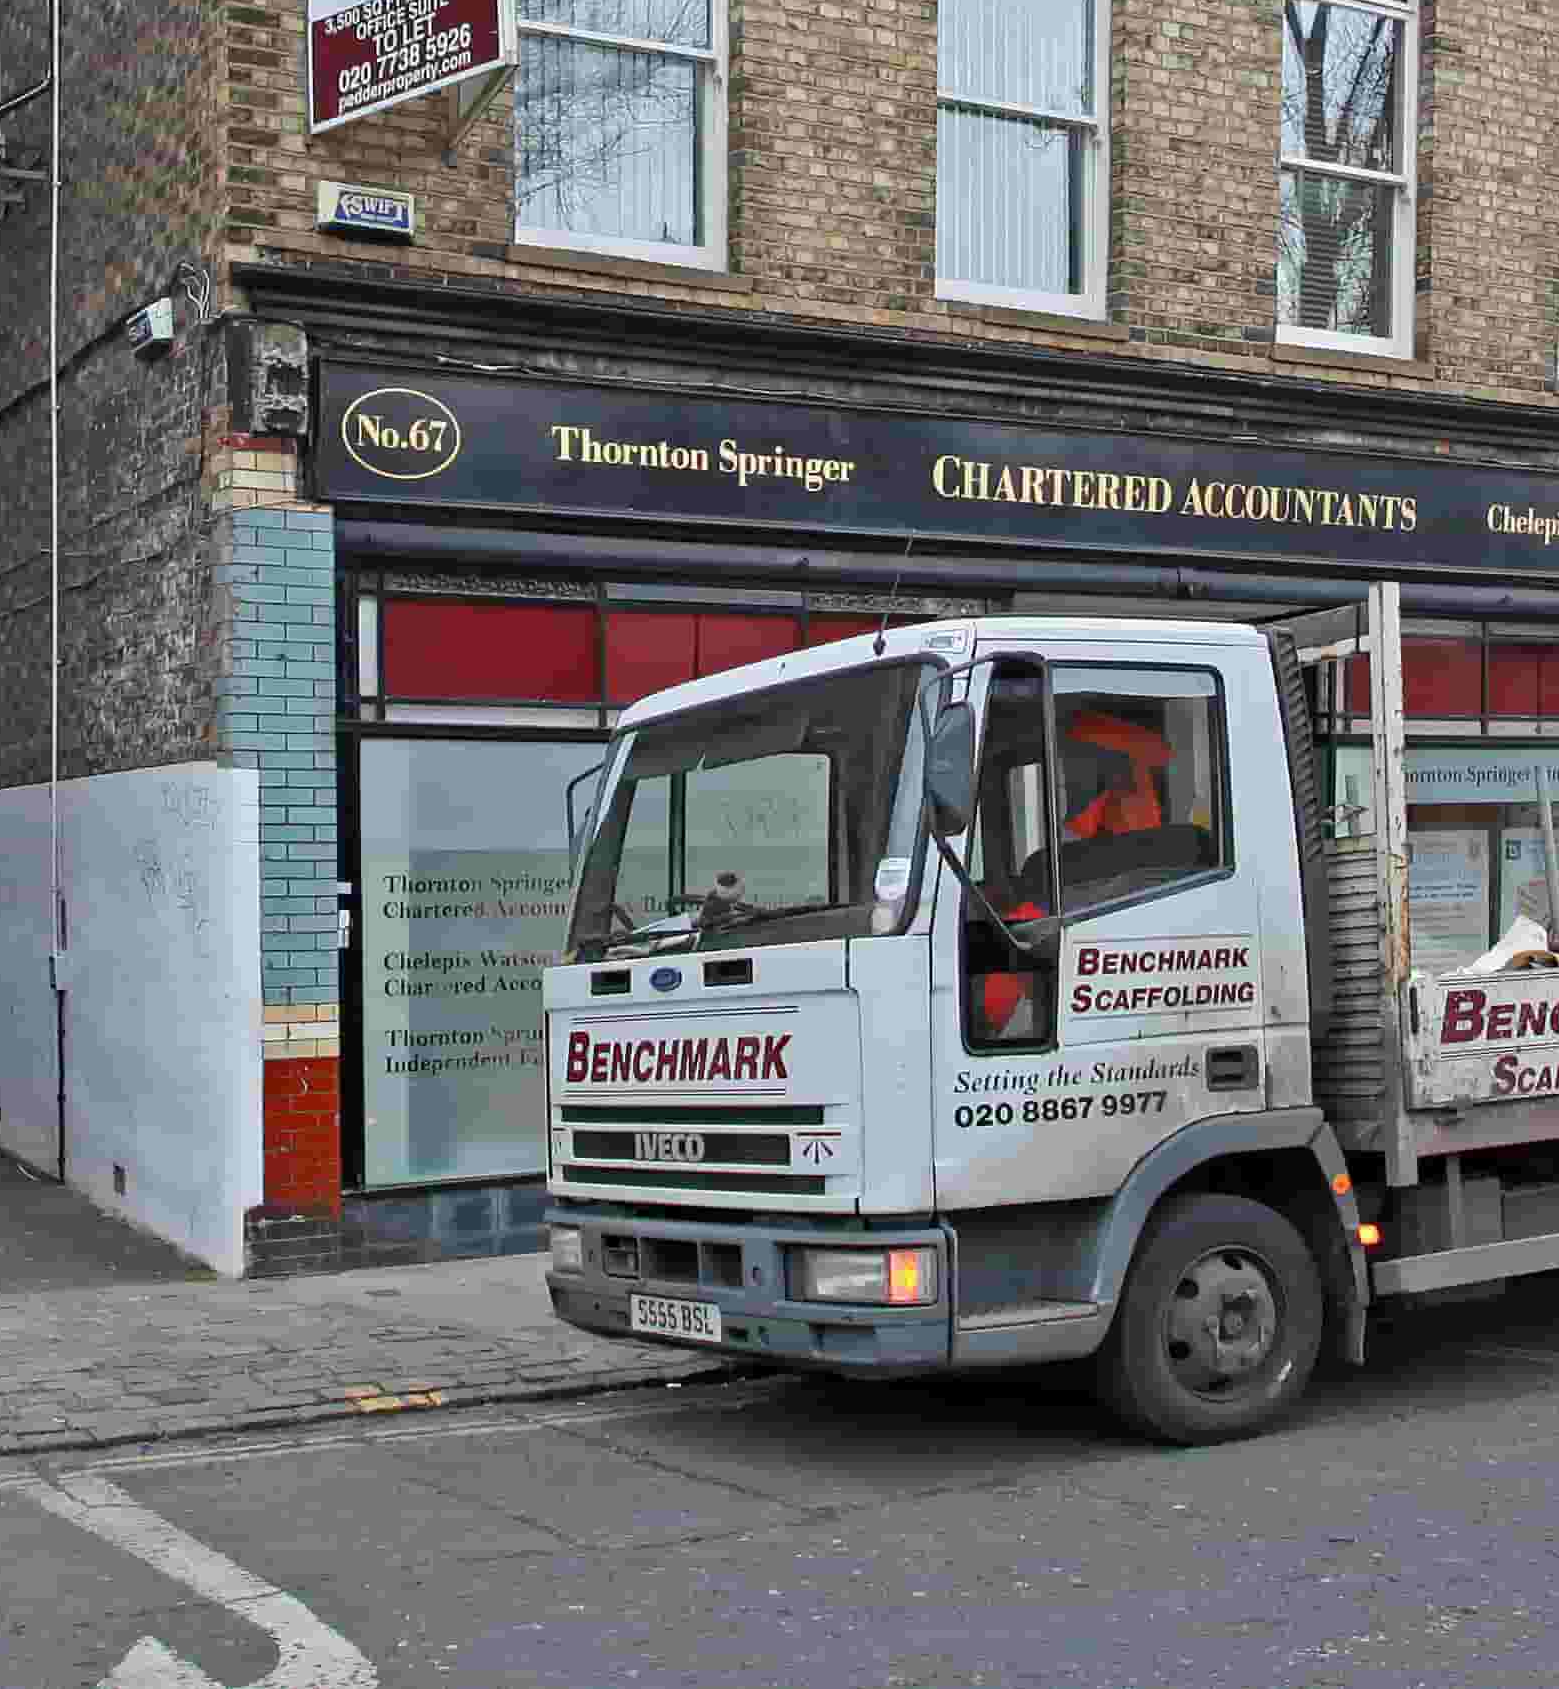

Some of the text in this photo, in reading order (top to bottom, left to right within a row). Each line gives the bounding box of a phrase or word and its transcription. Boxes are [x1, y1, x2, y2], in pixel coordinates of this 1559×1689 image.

[356, 5, 405, 41] OFFICE
[364, 0, 384, 22] SQ
[373, 13, 437, 56] TO LET
[338, 23, 472, 94] 020 7738 5926
[337, 49, 472, 114] pedderproperty.com
[356, 413, 447, 454] No.67
[551, 424, 856, 491] Thornton Springer
[932, 453, 1418, 532] CHARTERED ACCOUNTANTS
[1464, 764, 1531, 789] Springer
[383, 873, 482, 894] Thornton
[382, 900, 484, 919] Chartered
[383, 950, 472, 975] Chelepis
[1078, 946, 1250, 976] BENCHMARK
[1070, 983, 1255, 1013] SCAFFOLDING
[383, 1028, 485, 1048] Thornton
[566, 1029, 792, 1083] BENCHMARK
[953, 1054, 1201, 1095] Setting the Standards
[953, 1090, 1168, 1128] 020 8867 9977
[633, 1133, 705, 1162] IVECO
